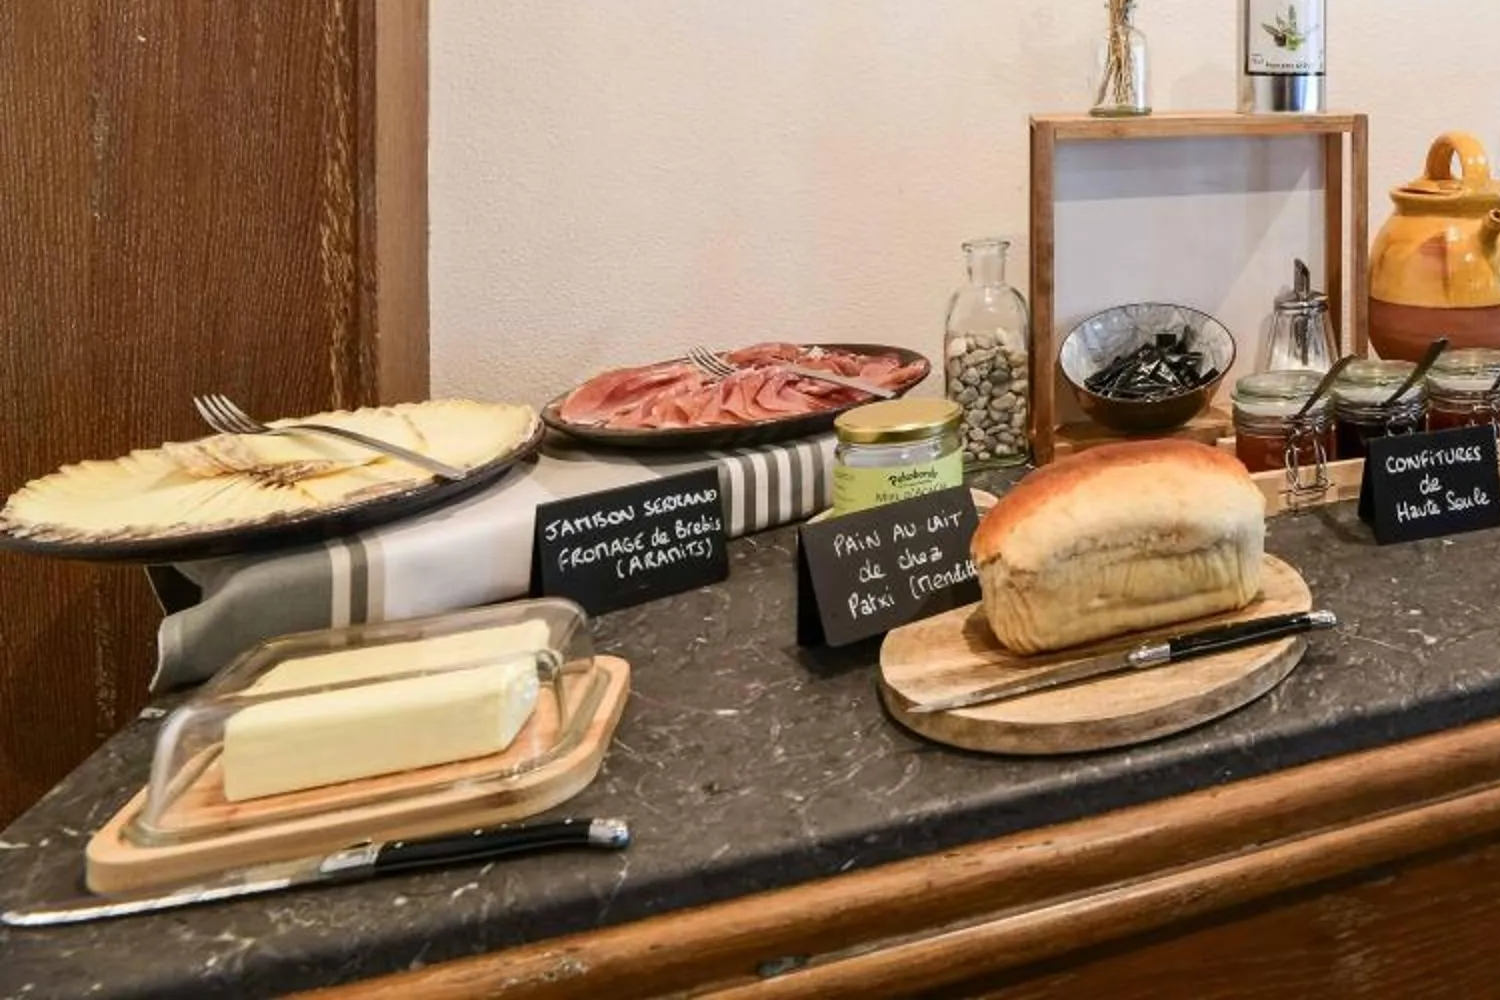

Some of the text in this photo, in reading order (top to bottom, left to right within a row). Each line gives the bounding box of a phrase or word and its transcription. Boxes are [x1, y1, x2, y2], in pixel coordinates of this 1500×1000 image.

[1385, 445, 1483, 474] CONFITURES
[1419, 473, 1444, 496] de
[545, 489, 717, 541] JAMBON SERRANO
[1396, 487, 1491, 524] Haute Soule
[558, 514, 721, 572] FROMAGE de Brebis
[616, 537, 714, 578] (ARAMITS)
[833, 530, 881, 558] PAIN
[893, 522, 917, 543] AU
[859, 545, 944, 583] de chez
[848, 585, 895, 620] Patxi
